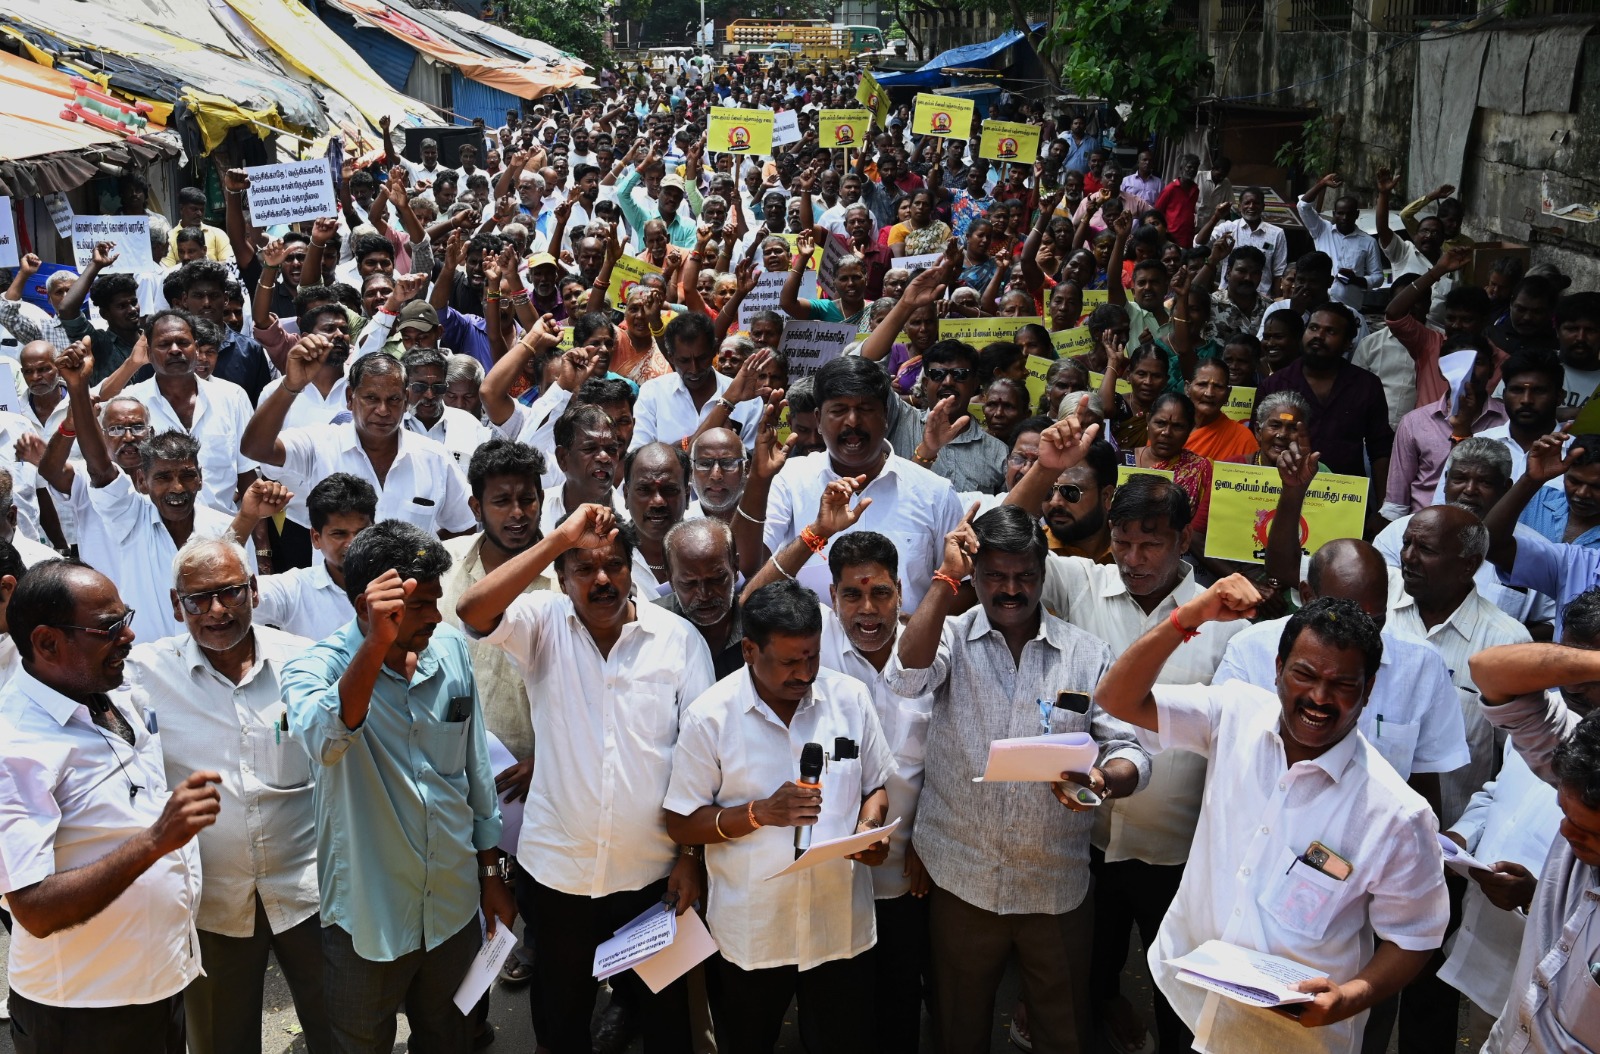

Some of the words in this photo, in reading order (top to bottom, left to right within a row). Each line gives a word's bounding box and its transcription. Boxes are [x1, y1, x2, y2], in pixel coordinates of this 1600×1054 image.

[1262, 481, 1282, 494] மீனவ
[1305, 486, 1340, 503] சாயத்து
[1342, 494, 1362, 503] சபை
